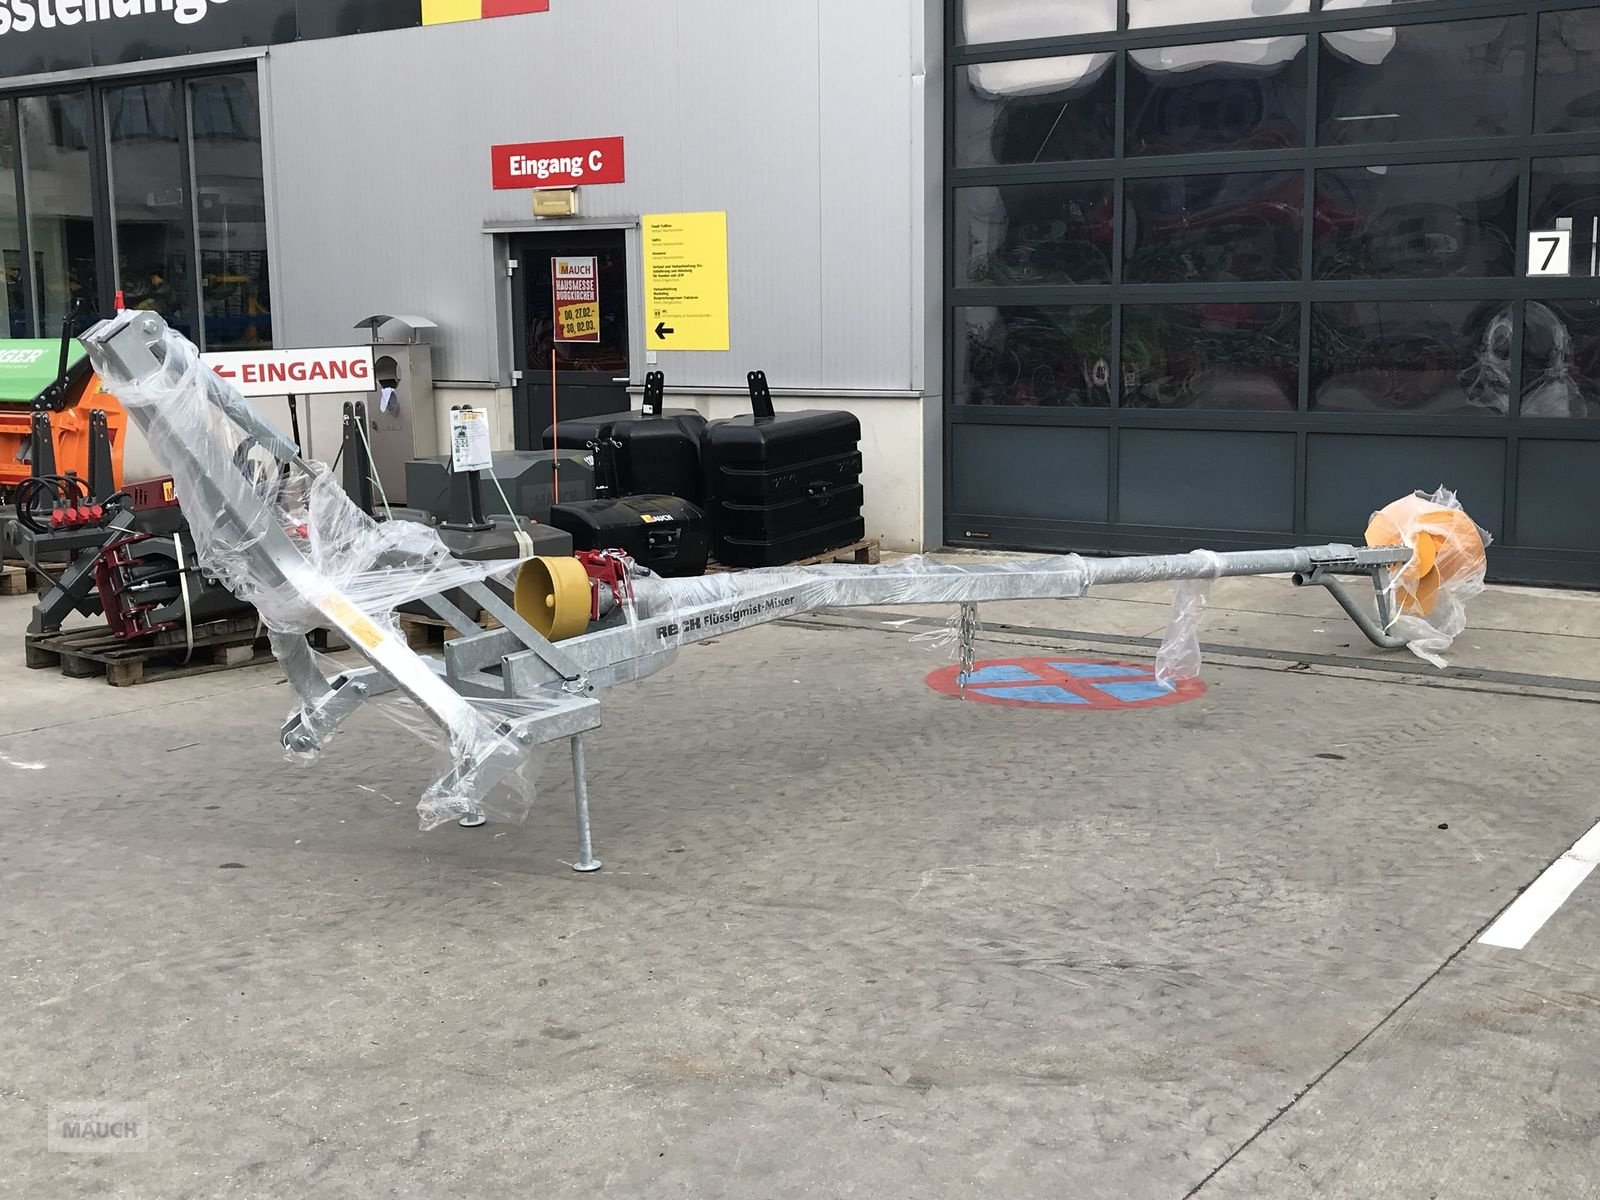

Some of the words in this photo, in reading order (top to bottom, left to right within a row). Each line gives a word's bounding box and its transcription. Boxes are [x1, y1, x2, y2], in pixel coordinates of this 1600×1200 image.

[509, 155, 584, 179] Eingang
[588, 150, 603, 171] C
[1537, 237, 1560, 271] 7
[560, 265, 591, 275] MAUCH
[555, 280, 595, 291] HAUSMESSE
[556, 291, 595, 301] BURGKIRCHEN
[564, 309, 574, 321] DO,
[566, 323, 576, 334] SO,
[576, 320, 596, 332] 02.03.
[242, 359, 368, 383] EINGANG
[703, 596, 796, 627] Flüssigmist-Mixer
